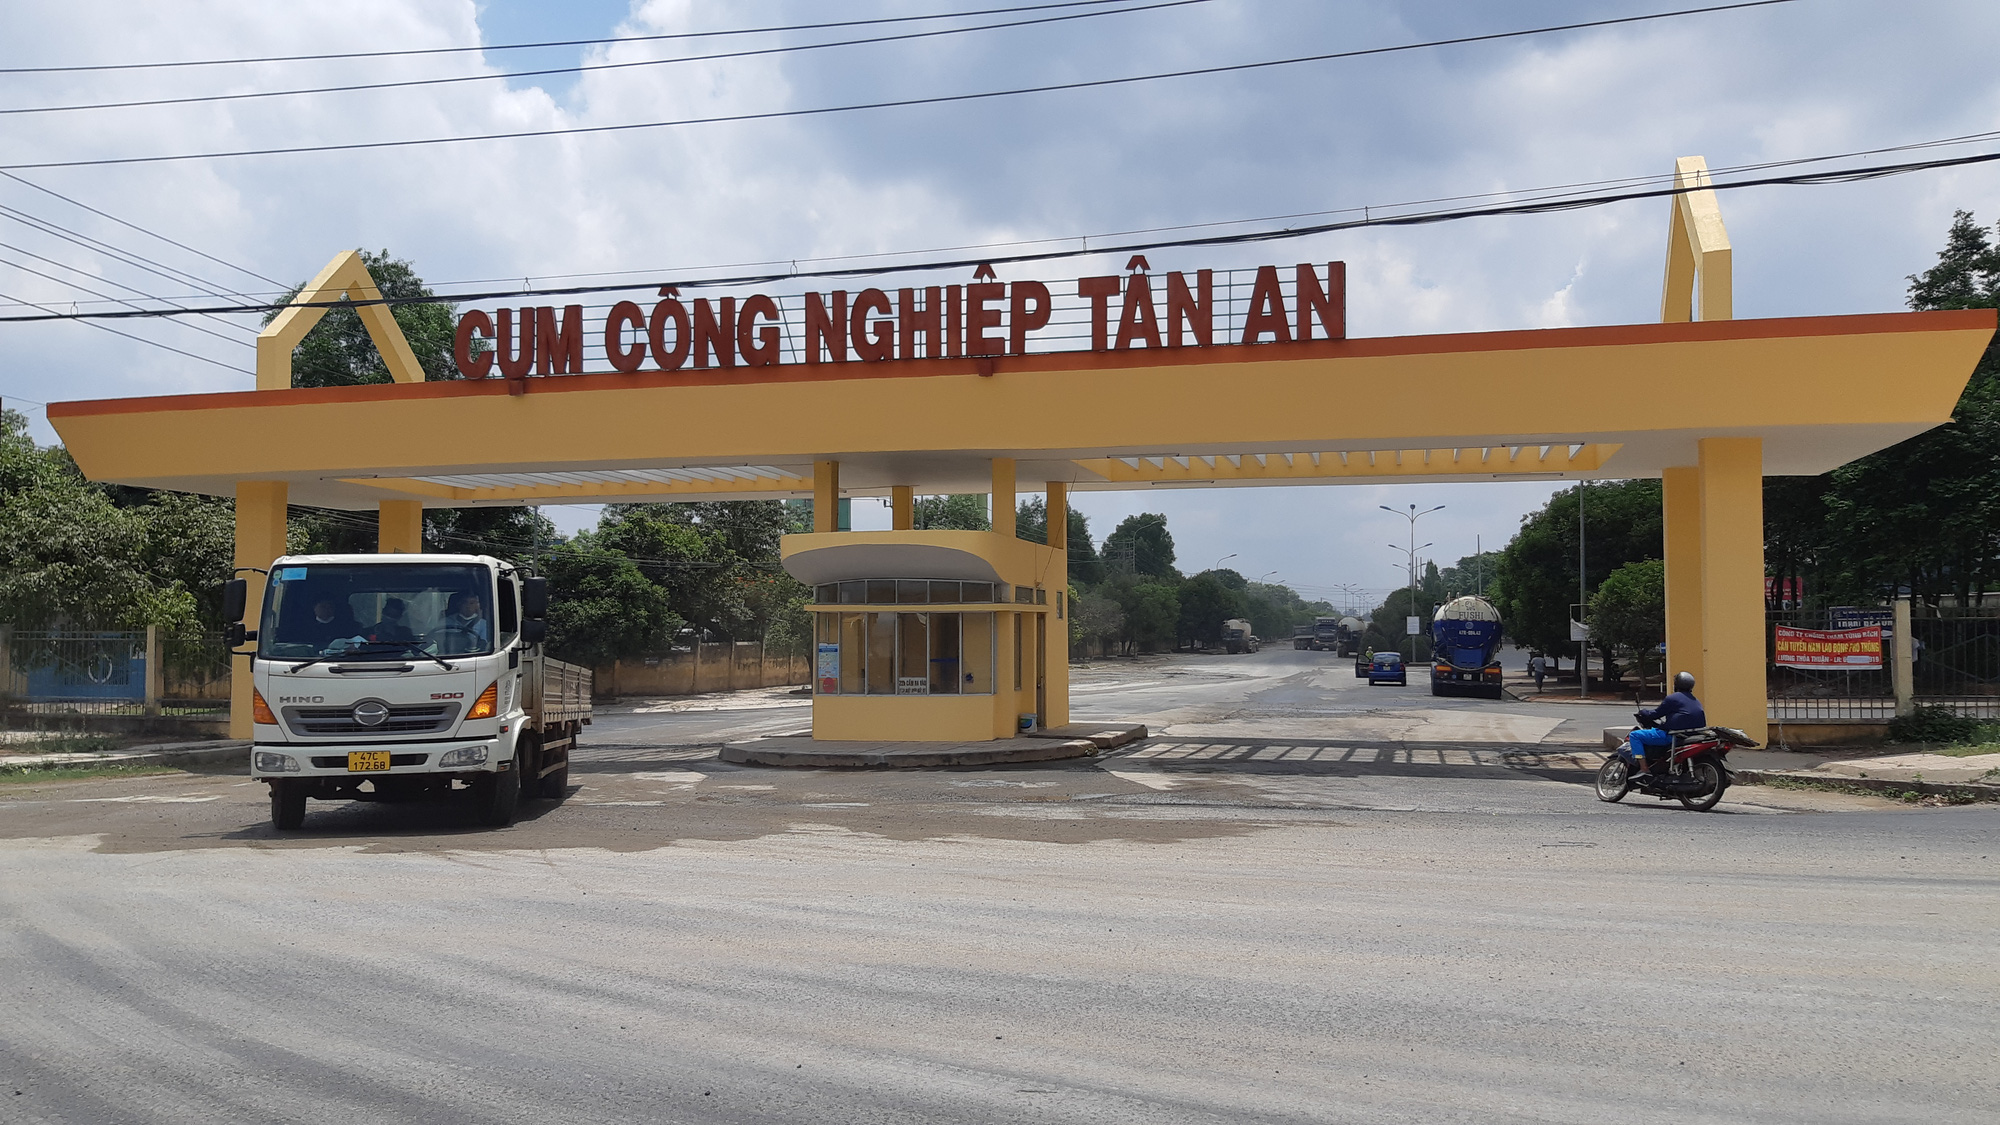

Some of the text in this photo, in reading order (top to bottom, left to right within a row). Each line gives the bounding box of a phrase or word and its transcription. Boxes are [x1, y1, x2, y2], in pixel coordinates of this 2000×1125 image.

[454, 254, 1346, 396] CỤM CÔNG NGHIỆP TÂN AN
[1459, 611, 1484, 620] FUSHI
[1807, 642, 1821, 652] NAM
[1821, 642, 1832, 653] LAO
[279, 695, 325, 703] HINO
[430, 692, 464, 700] 500
[360, 752, 379, 761] 47C
[354, 761, 386, 770] 172.68
